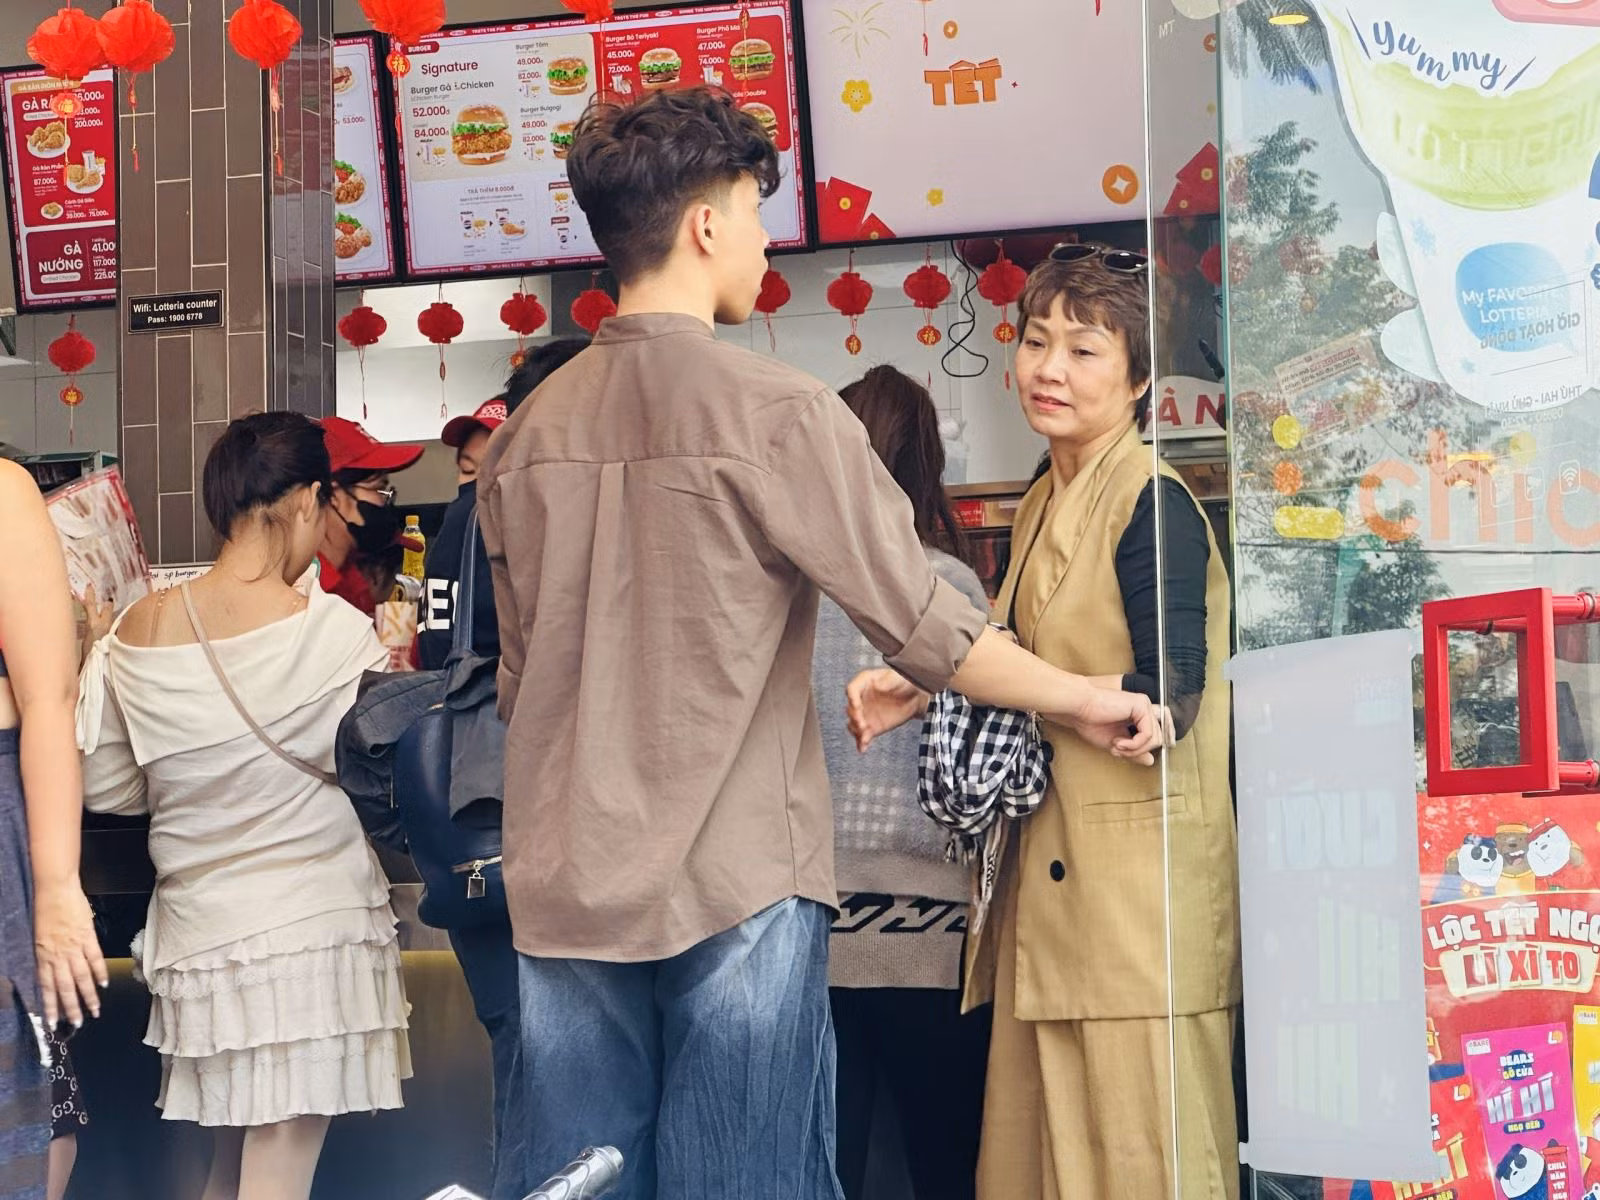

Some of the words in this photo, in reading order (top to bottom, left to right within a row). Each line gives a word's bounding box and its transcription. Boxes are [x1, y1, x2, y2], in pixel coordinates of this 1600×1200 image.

[605, 35, 625, 43] Burger
[408, 45, 432, 53] BURGER
[1373, 21, 1507, 90] Yummy
[421, 61, 479, 78] Signature
[924, 57, 1002, 106] TẾT
[410, 86, 438, 95] Burger
[22, 96, 39, 111] GÀ
[520, 106, 539, 114] Burger
[63, 240, 82, 256] GÀ
[38, 256, 84, 273] NƯỚNG
[133, 303, 152, 313] Wifi:
[153, 300, 185, 312] Lotteria
[186, 299, 217, 309] counter
[1462, 289, 1484, 308] My
[147, 316, 167, 324] Pass:
[168, 313, 185, 322] 1900
[186, 312, 203, 320] 6778
[1427, 914, 1482, 952] LỘC
[1484, 901, 1540, 938] TẾT
[1500, 1052, 1535, 1067] BEARS
[1486, 1085, 1514, 1124] HÍ
[1520, 1071, 1555, 1118] HÍ
